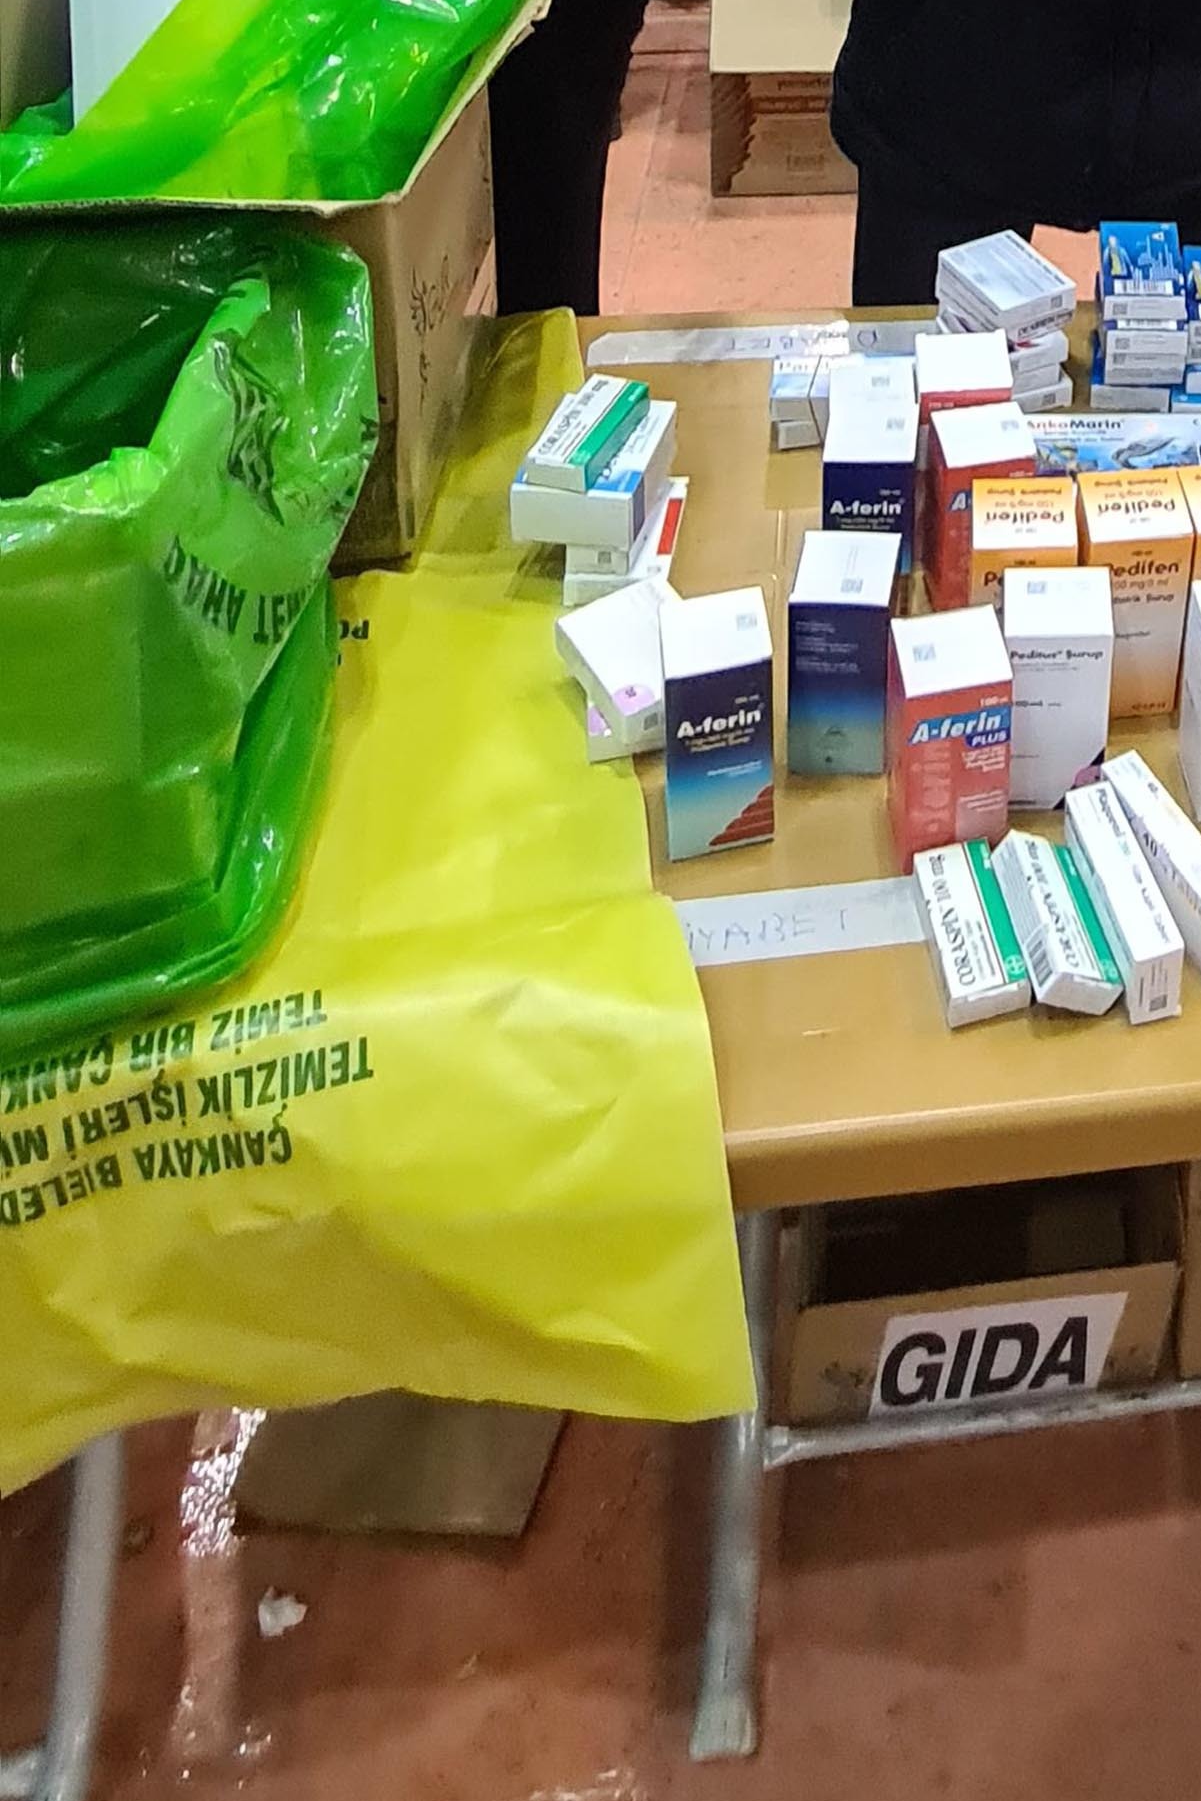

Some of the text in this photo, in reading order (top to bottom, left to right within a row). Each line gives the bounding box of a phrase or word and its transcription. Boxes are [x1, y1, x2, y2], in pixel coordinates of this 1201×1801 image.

[677, 710, 761, 739] A-ferin
[912, 711, 1001, 744] A-ferin
[971, 731, 1006, 747] PLUS
[129, 1019, 197, 1075] BİR
[209, 988, 328, 1056] TEMİZ
[197, 1036, 375, 1122] TEMİZLİK
[62, 1068, 188, 1161] İŞLERİ
[133, 1103, 293, 1181] ÇANKAYA
[880, 1315, 1089, 1407] GIDA
